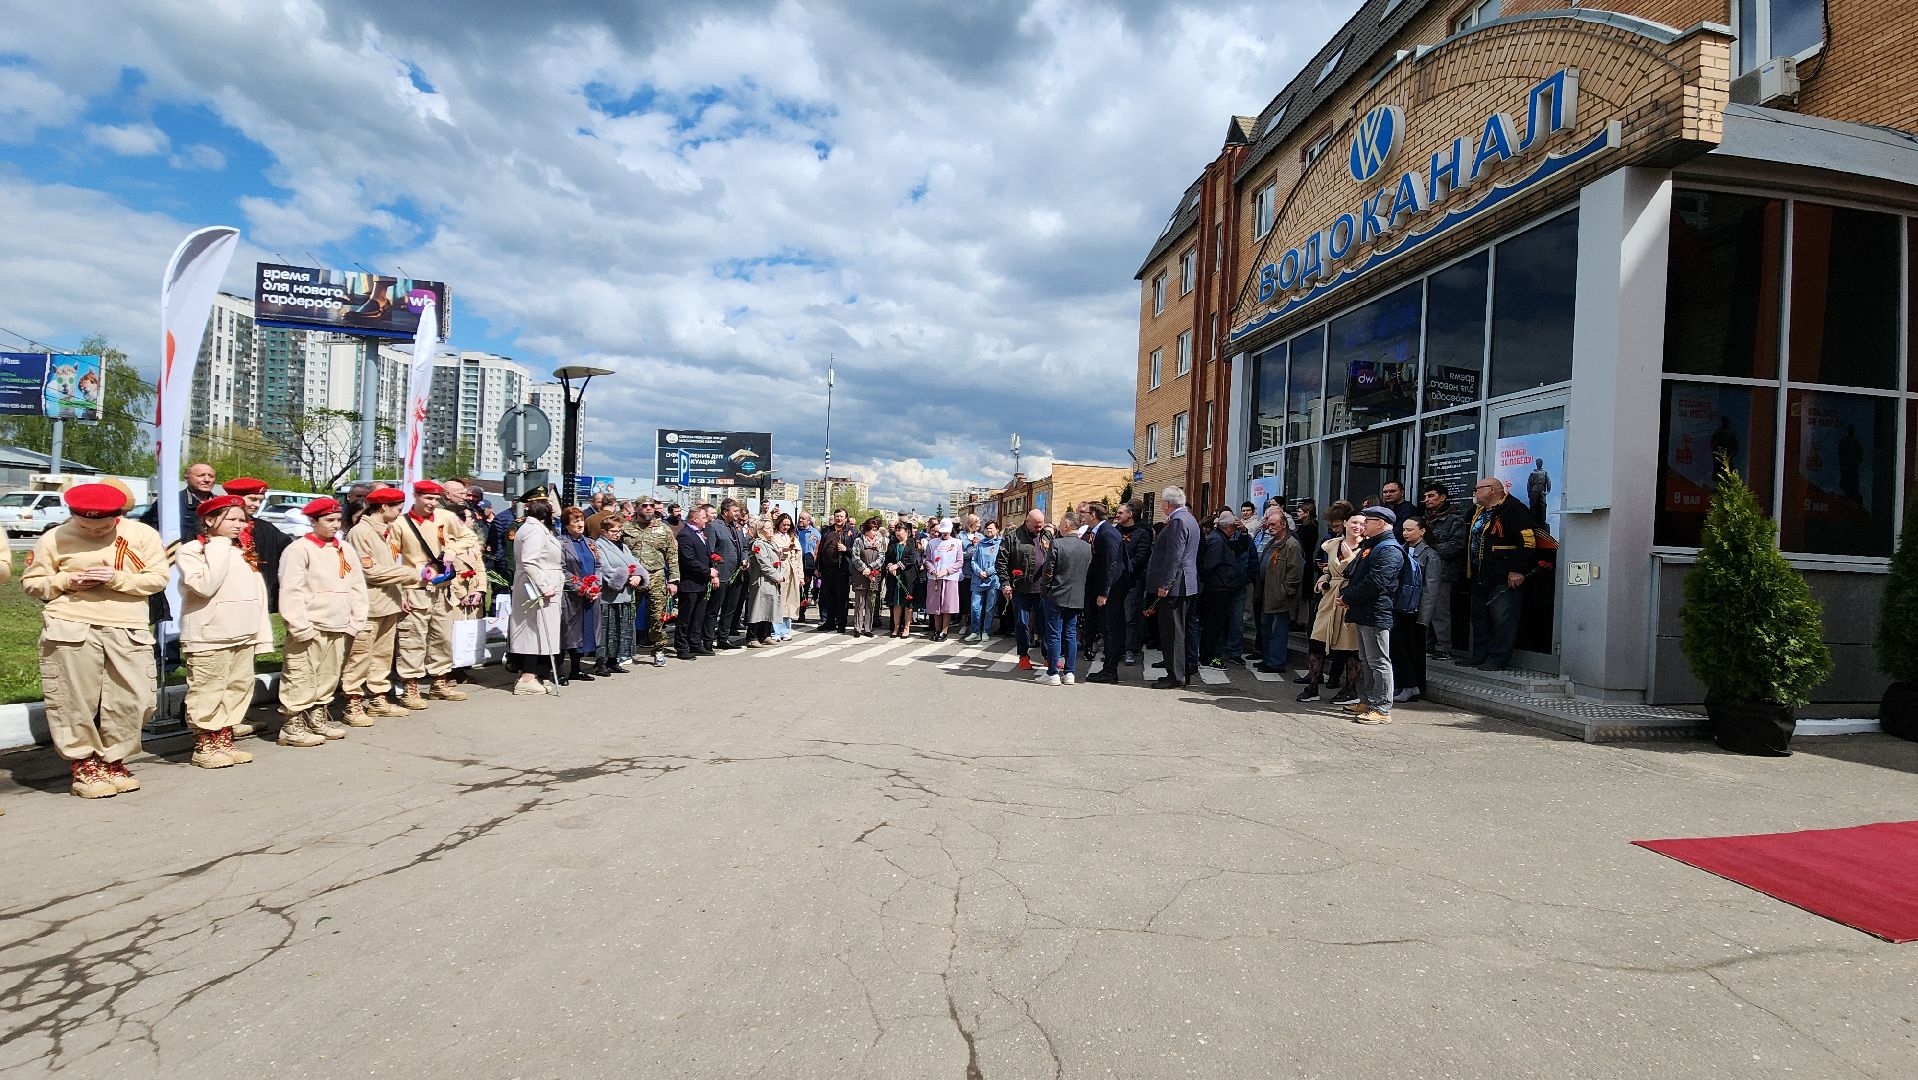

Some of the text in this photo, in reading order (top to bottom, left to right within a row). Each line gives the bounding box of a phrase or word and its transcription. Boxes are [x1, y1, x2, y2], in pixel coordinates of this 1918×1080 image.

[1258, 68, 1578, 304] ВОДОКАНАЛ
[263, 269, 310, 282] время
[262, 279, 344, 298] для нового
[262, 292, 342, 309] гардероба
[1500, 456, 1534, 467] ЗА ПОБЕДУ!
[1501, 448, 1527, 458] СПАСИБО
[680, 454, 688, 482] P
